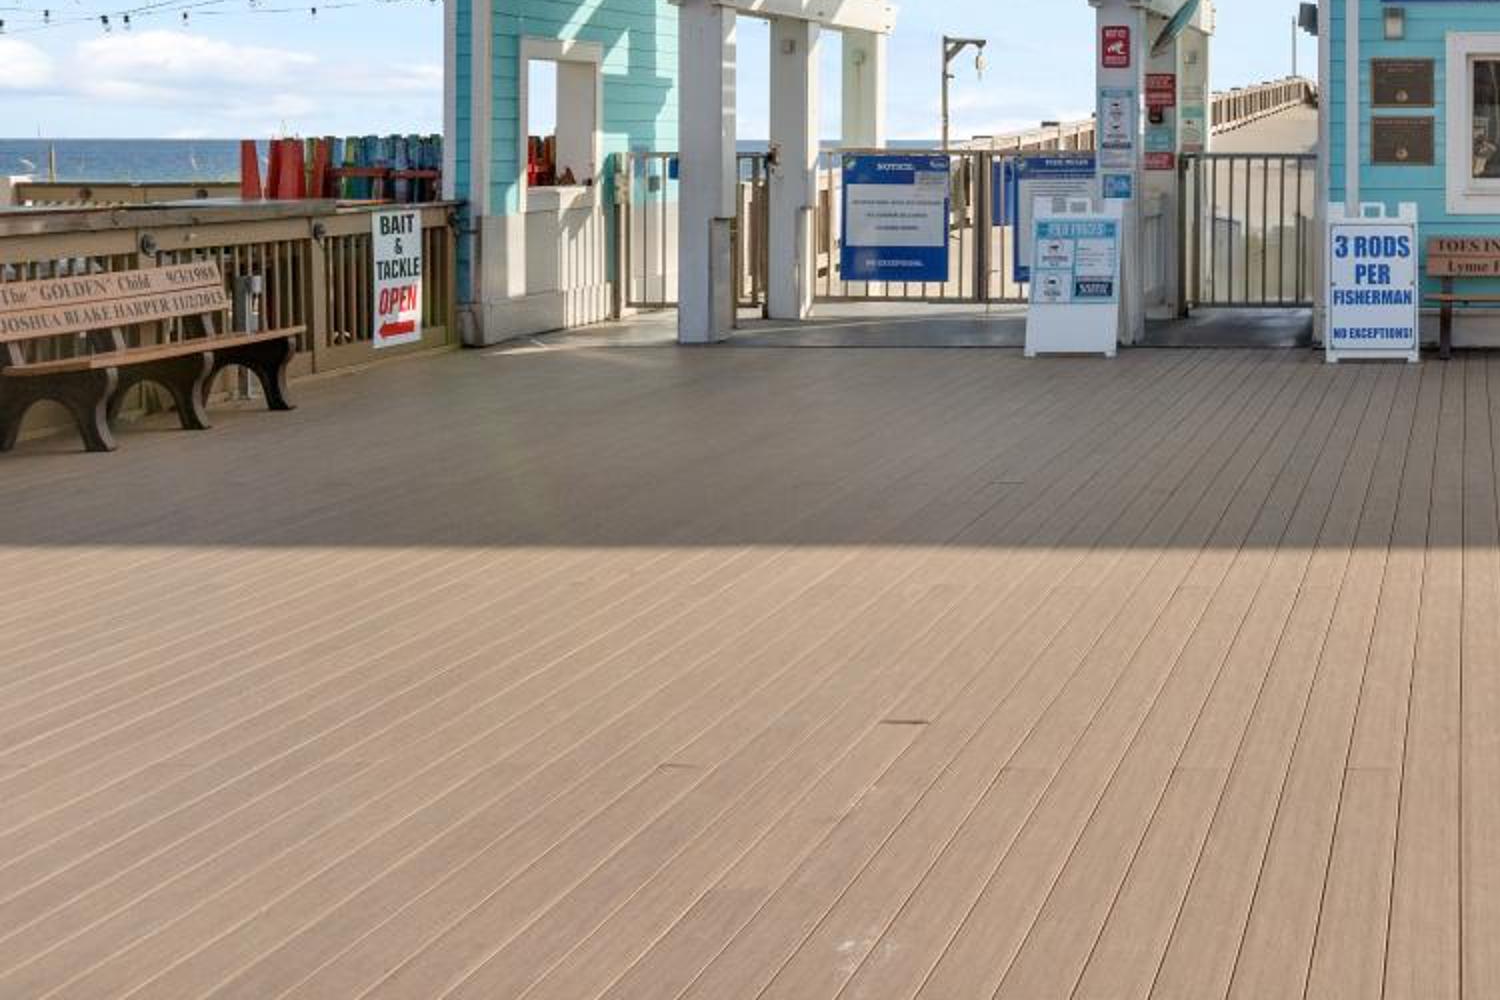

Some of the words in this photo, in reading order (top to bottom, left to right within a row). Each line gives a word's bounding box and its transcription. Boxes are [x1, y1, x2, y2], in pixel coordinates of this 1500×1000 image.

[379, 214, 414, 236] BAIT
[394, 238, 403, 254] &
[1335, 235, 1349, 258] 3
[1354, 235, 1410, 258] RODS
[1439, 240, 1479, 252] TOES
[376, 257, 420, 280] TACKLE
[1355, 263, 1391, 285] PER
[1447, 260, 1489, 277] Lynne
[1, 287, 27, 305] The
[118, 273, 152, 291] Child
[379, 284, 417, 315] OPEN
[1333, 289, 1413, 305] FISHERMAN
[0, 312, 61, 334] JOSHUA
[64, 305, 112, 324] BLAKE
[114, 297, 170, 318] HARPER
[1333, 327, 1347, 339] NO
[1350, 327, 1413, 339] EXCEPTIONS!
